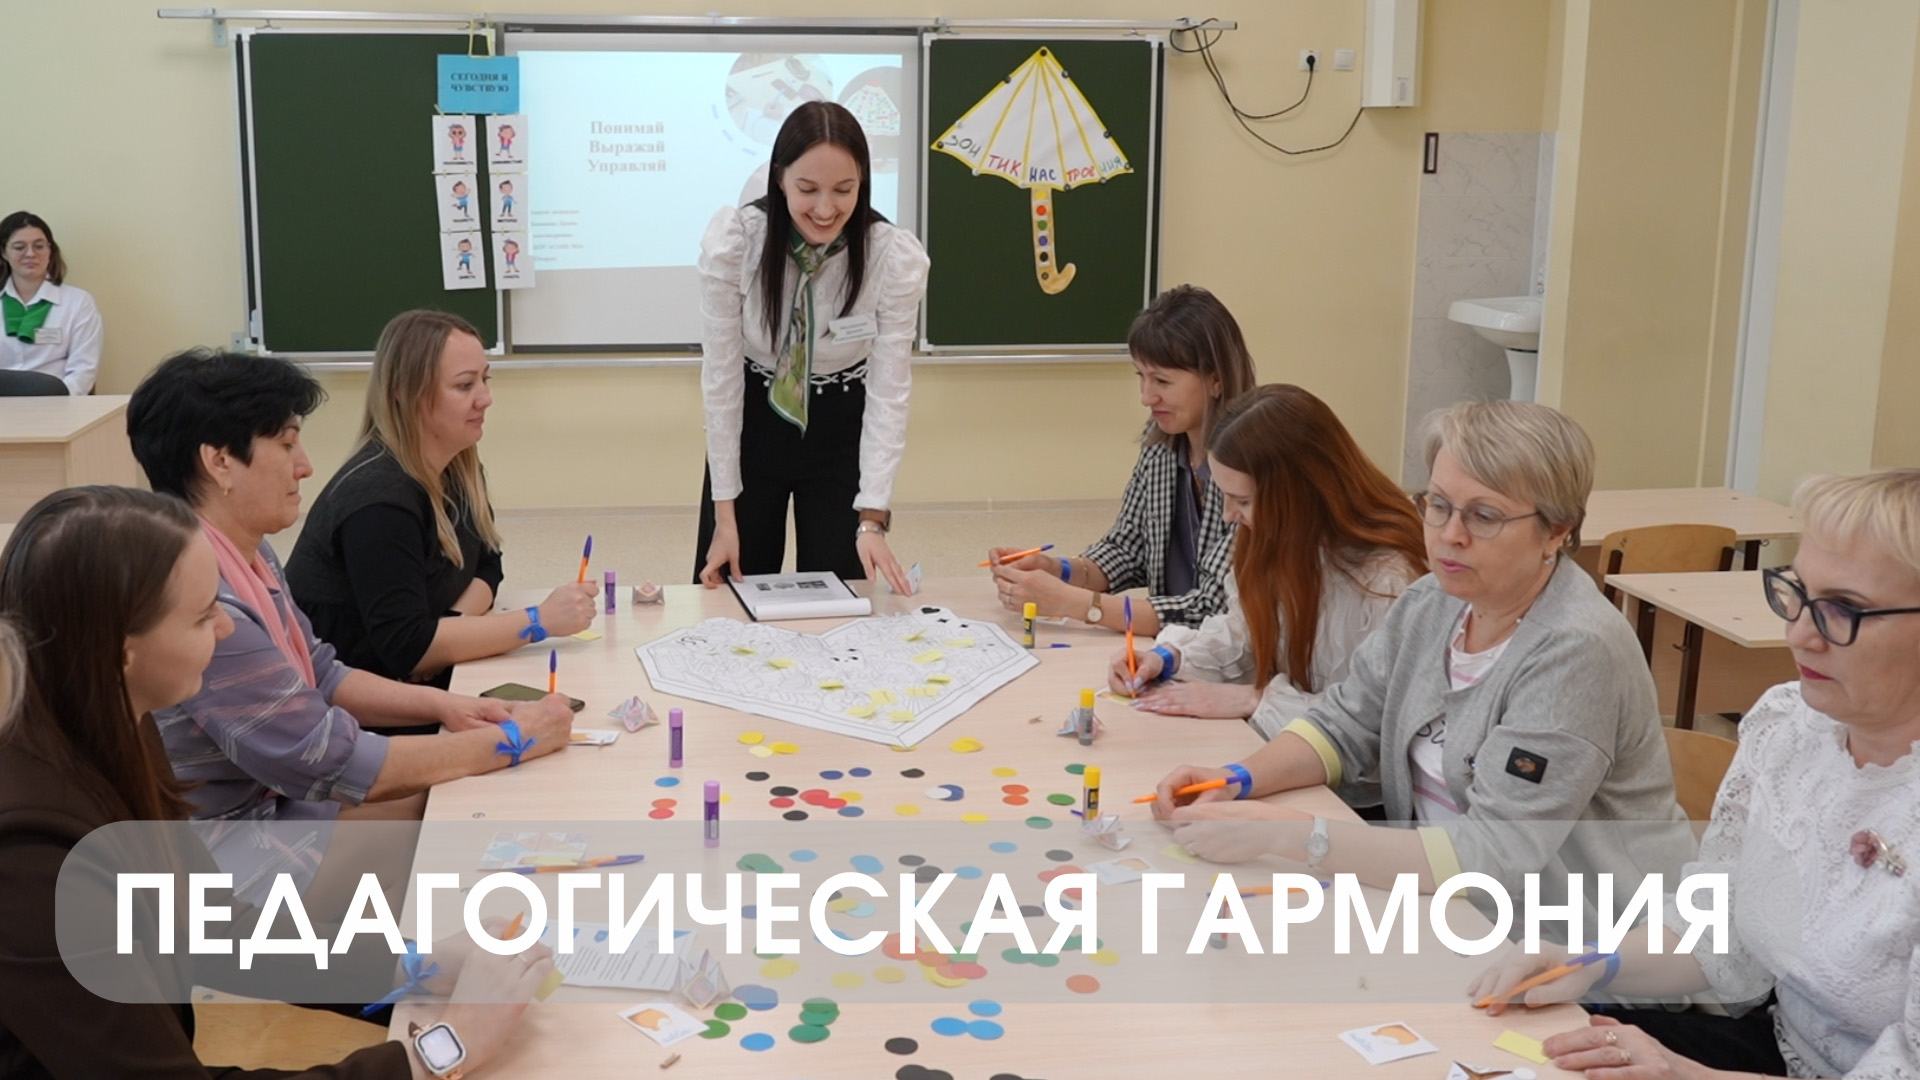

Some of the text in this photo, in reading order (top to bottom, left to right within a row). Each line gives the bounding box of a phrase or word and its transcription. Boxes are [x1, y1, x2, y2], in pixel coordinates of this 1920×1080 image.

[450, 72, 509, 81] СЕГОДНЯ Я
[450, 84, 510, 92] ЧУВСТВУЮ
[591, 121, 664, 134] Понимай
[589, 140, 665, 156] Выражай
[944, 134, 982, 158] ЗОН
[988, 154, 1023, 177] ТИК
[1029, 167, 1057, 182] НАС
[588, 159, 666, 175] Управляй
